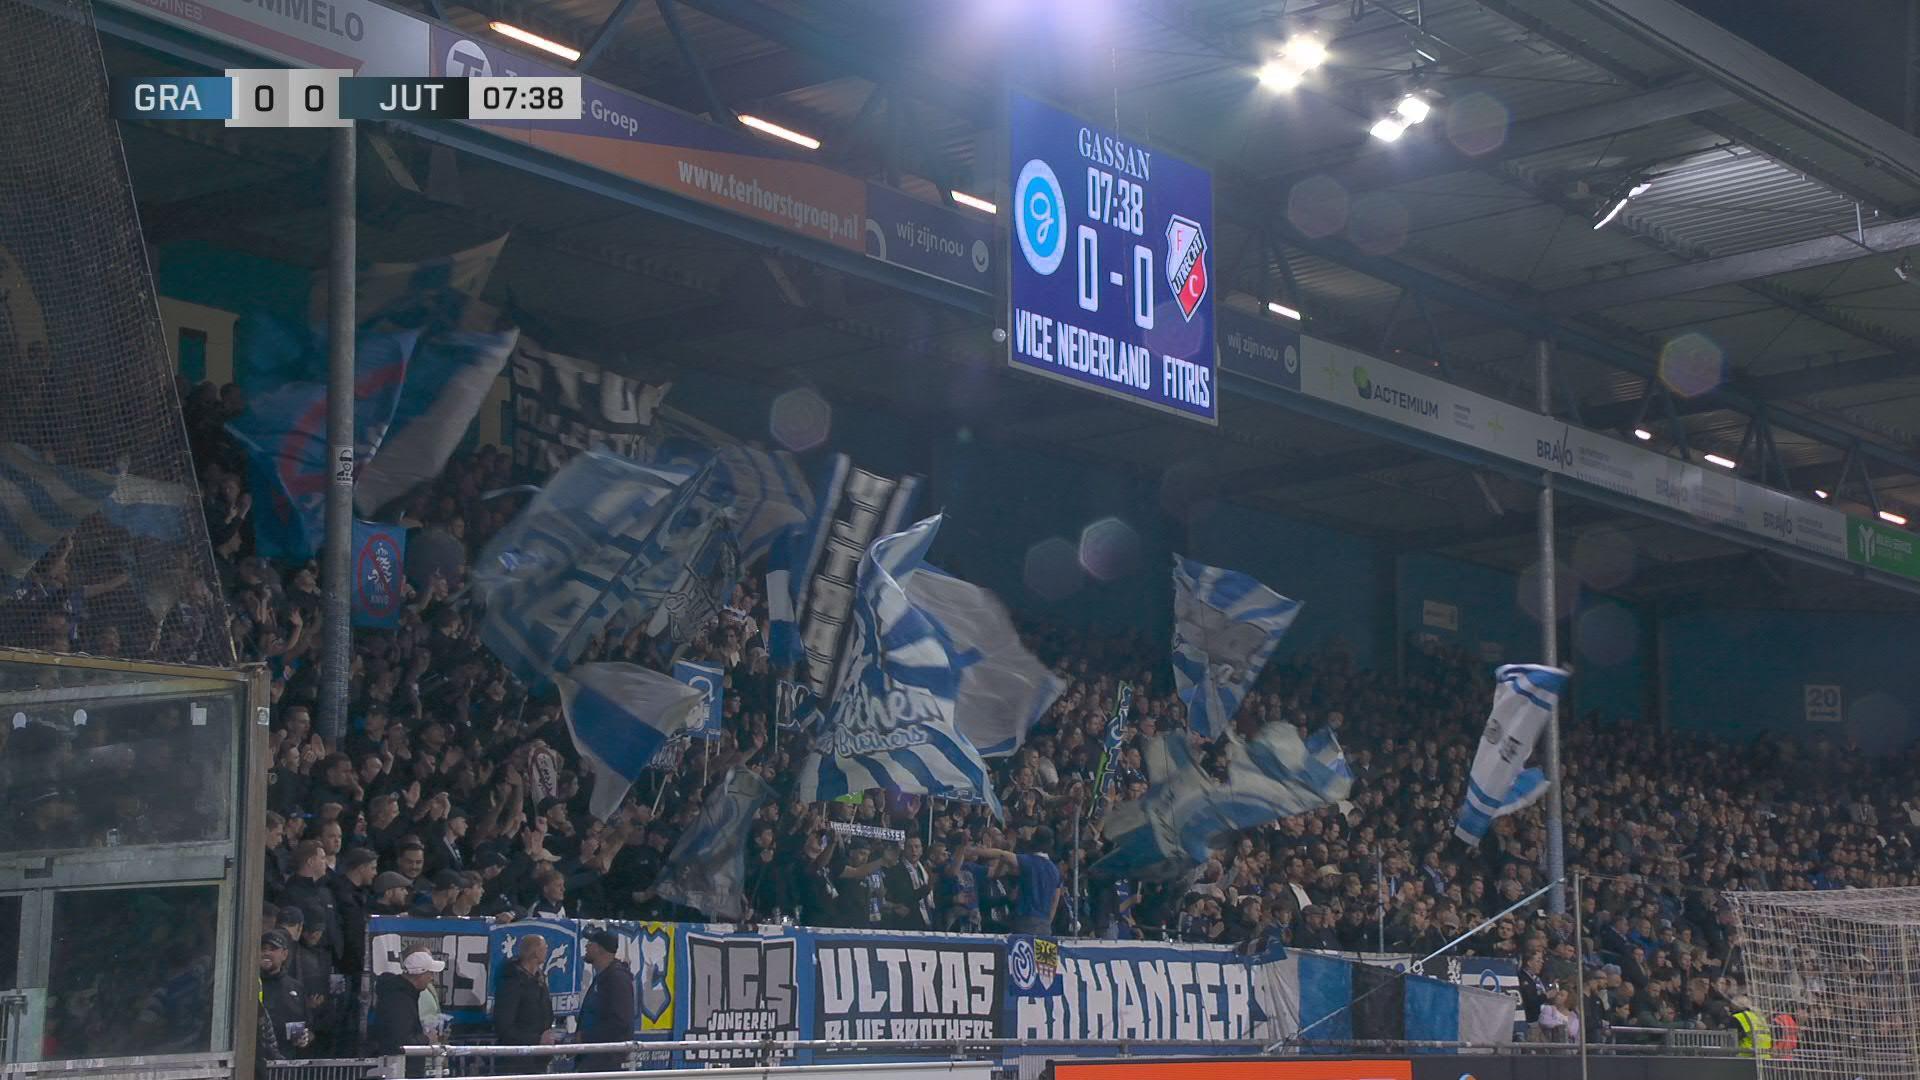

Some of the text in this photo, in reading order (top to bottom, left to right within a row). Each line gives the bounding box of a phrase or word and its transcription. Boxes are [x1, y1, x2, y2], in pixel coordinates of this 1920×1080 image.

[590, 99, 639, 137] Groep
[1078, 127, 1150, 182] GASSAN
[678, 160, 860, 241] www.terhorstgroep.nl
[1087, 166, 1144, 236] 07:38
[896, 220, 914, 247] wij
[1078, 224, 1098, 313] 0
[1133, 244, 1154, 330] 0
[1189, 274, 1199, 298] C
[1015, 307, 1210, 408] VICE NEDERLAND FITRIS
[1373, 384, 1439, 420] ACTEMIUM
[1536, 425, 1573, 470] BRAVO
[1808, 688, 1840, 708] 20
[818, 947, 995, 1015] ULTRAS
[707, 1011, 776, 1032] JONGEREN
[890, 1018, 993, 1050] BROTHERS
